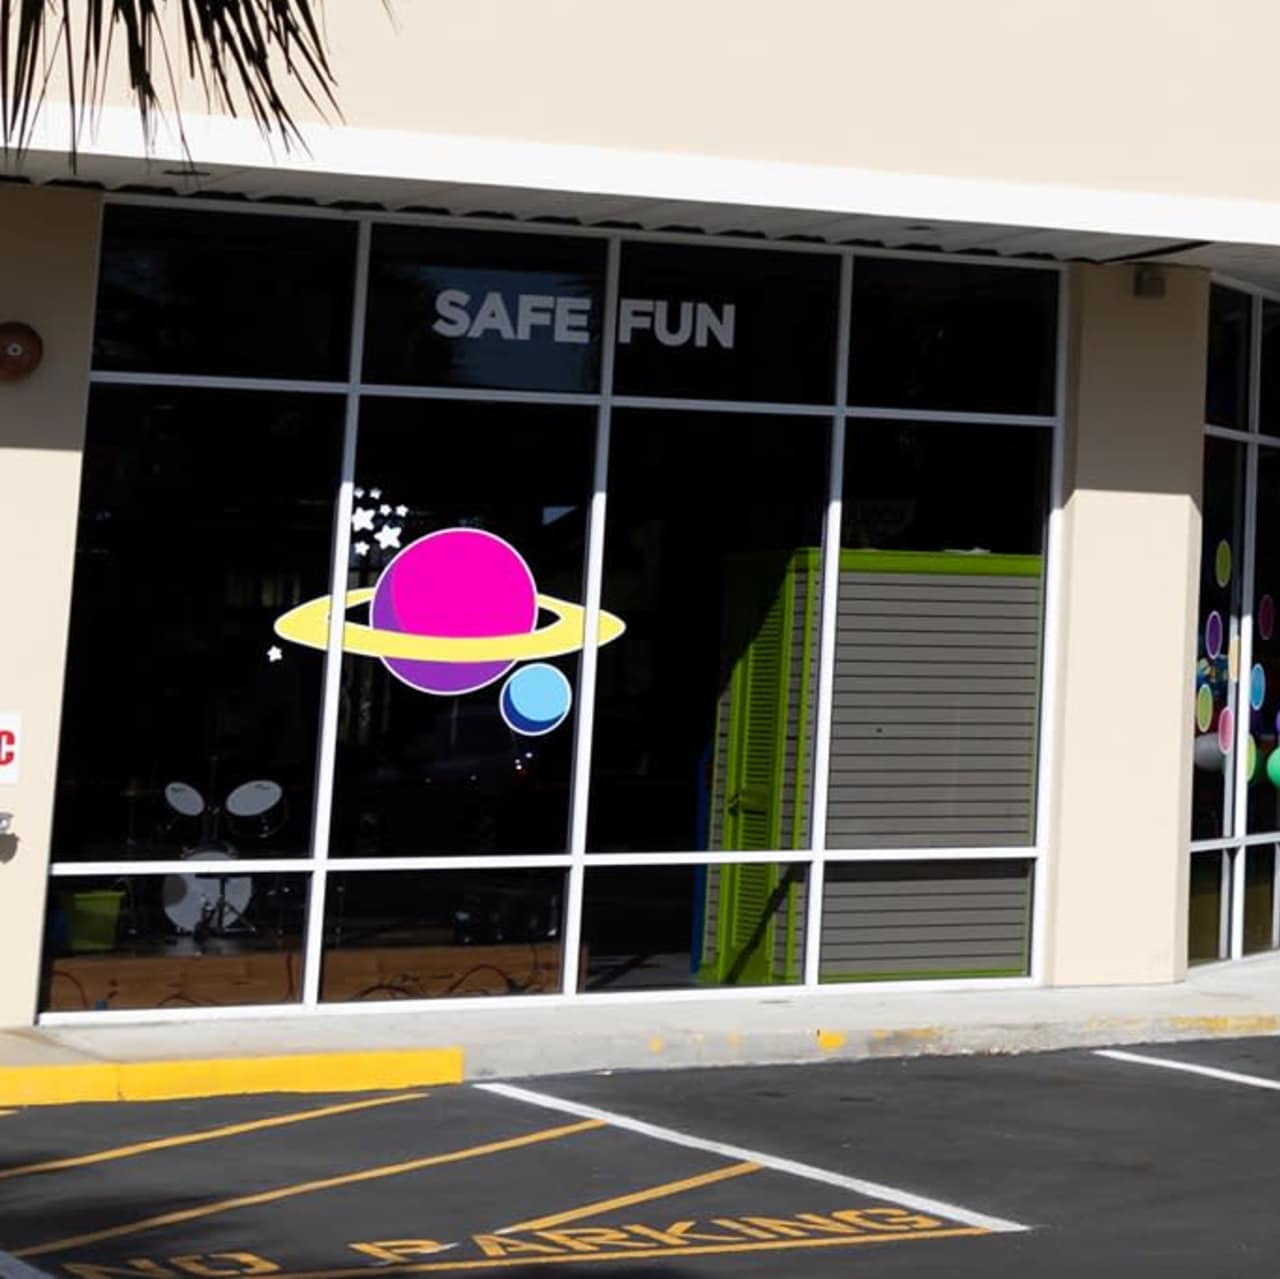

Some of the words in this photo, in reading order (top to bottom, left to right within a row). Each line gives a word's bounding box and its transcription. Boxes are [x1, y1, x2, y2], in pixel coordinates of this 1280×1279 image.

[432, 289, 592, 344] SAFE
[617, 297, 737, 349] FUN
[61, 1251, 283, 1279] NO
[348, 1206, 941, 1264] PARKING
